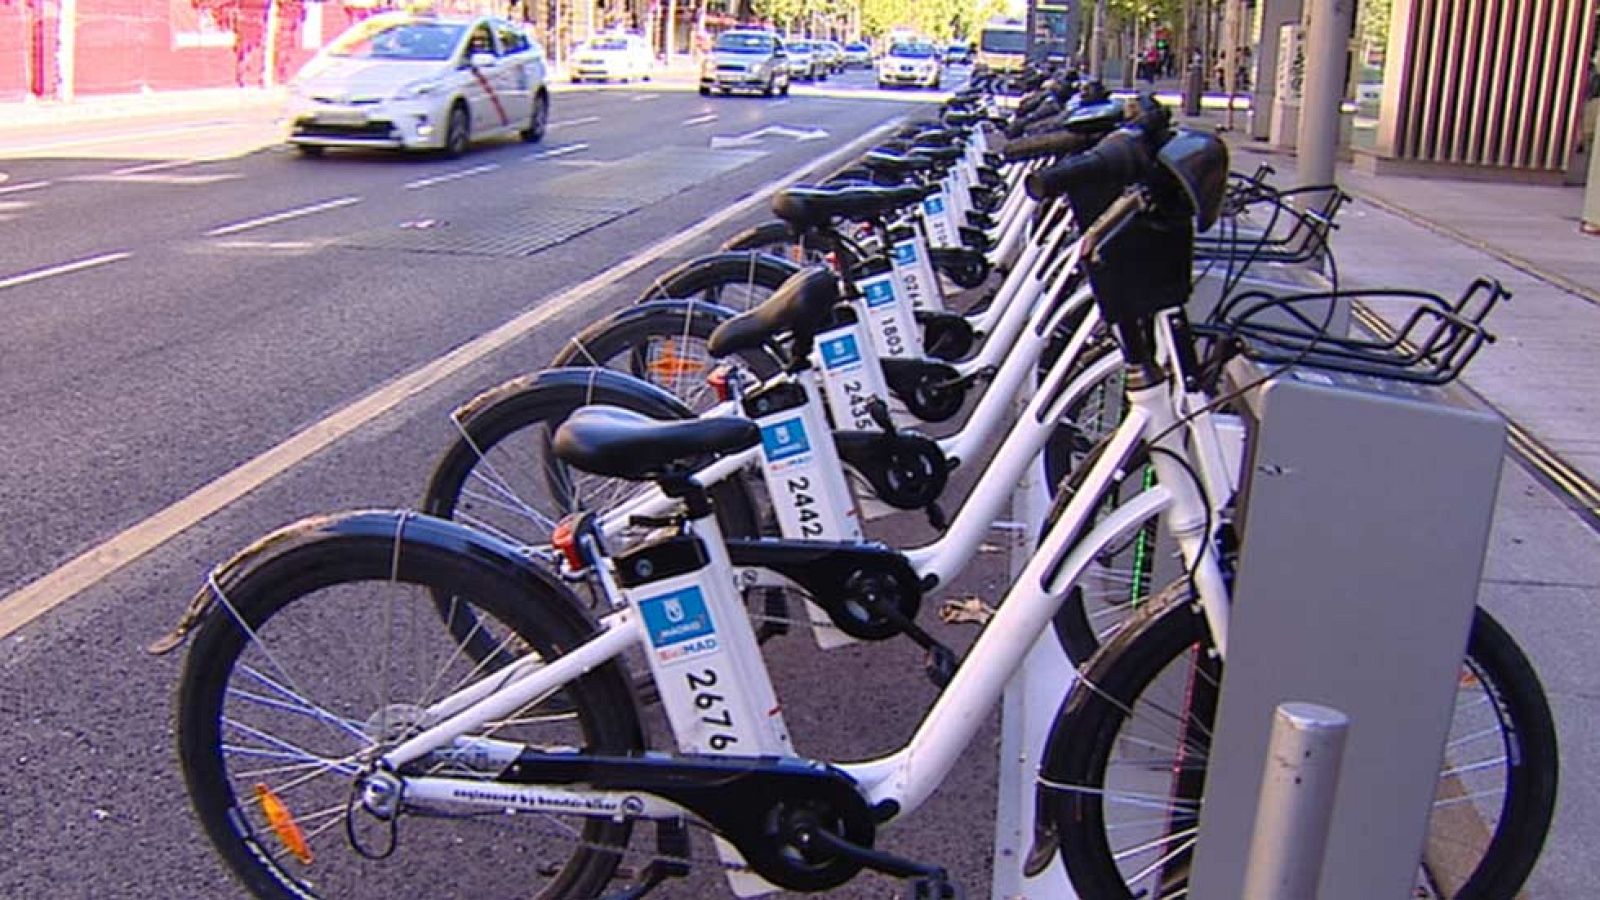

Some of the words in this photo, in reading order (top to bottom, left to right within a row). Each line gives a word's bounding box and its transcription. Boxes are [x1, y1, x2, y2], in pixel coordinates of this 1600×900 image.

[881, 316, 904, 355] 1803
[843, 380, 873, 429] 2435
[787, 476, 824, 538] 2442
[686, 669, 738, 751] 2676
